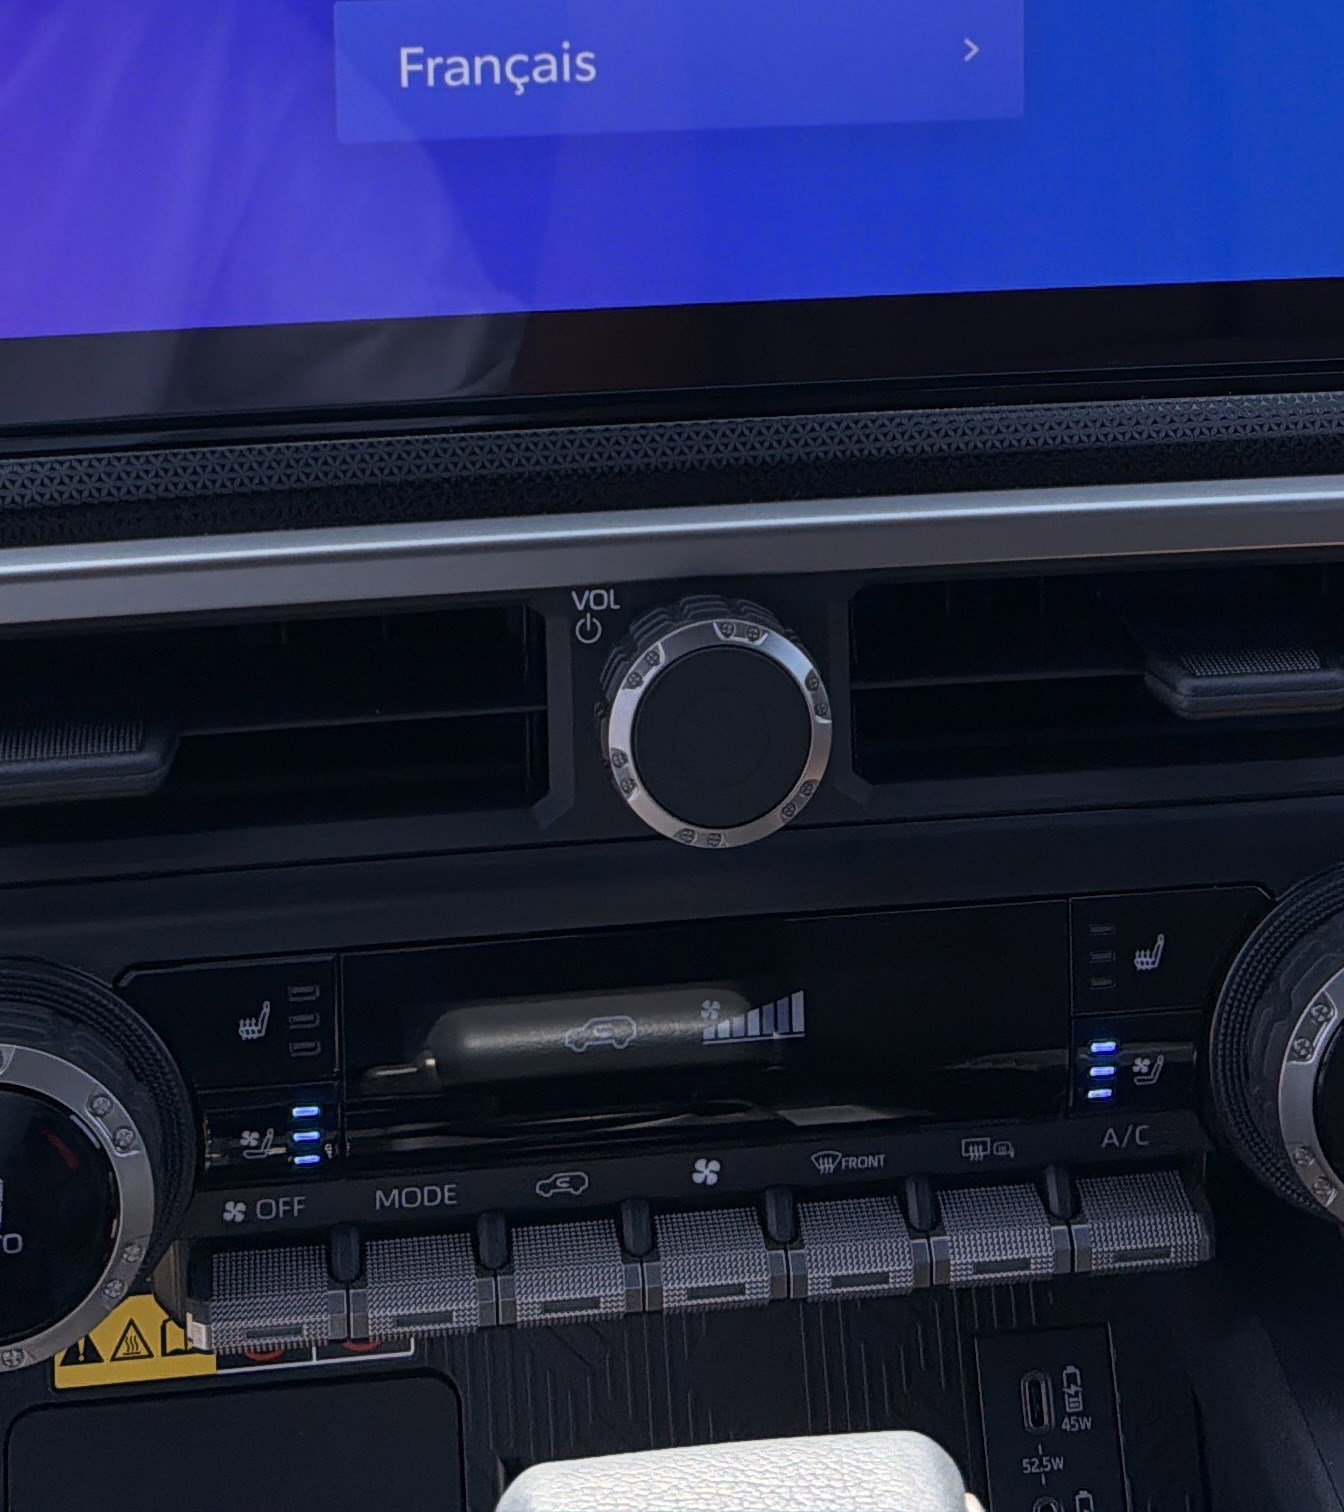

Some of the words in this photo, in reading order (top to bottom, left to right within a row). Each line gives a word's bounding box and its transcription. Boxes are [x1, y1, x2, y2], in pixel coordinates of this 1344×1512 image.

[398, 40, 598, 96] Français
[571, 588, 621, 611] VOL
[1101, 1124, 1151, 1149] A/C
[840, 1153, 886, 1169] FRONT
[256, 1195, 306, 1221] OFF
[374, 1183, 458, 1211] MODE
[1061, 1416, 1093, 1433] 45W
[1022, 1455, 1065, 1475] 52.5W
